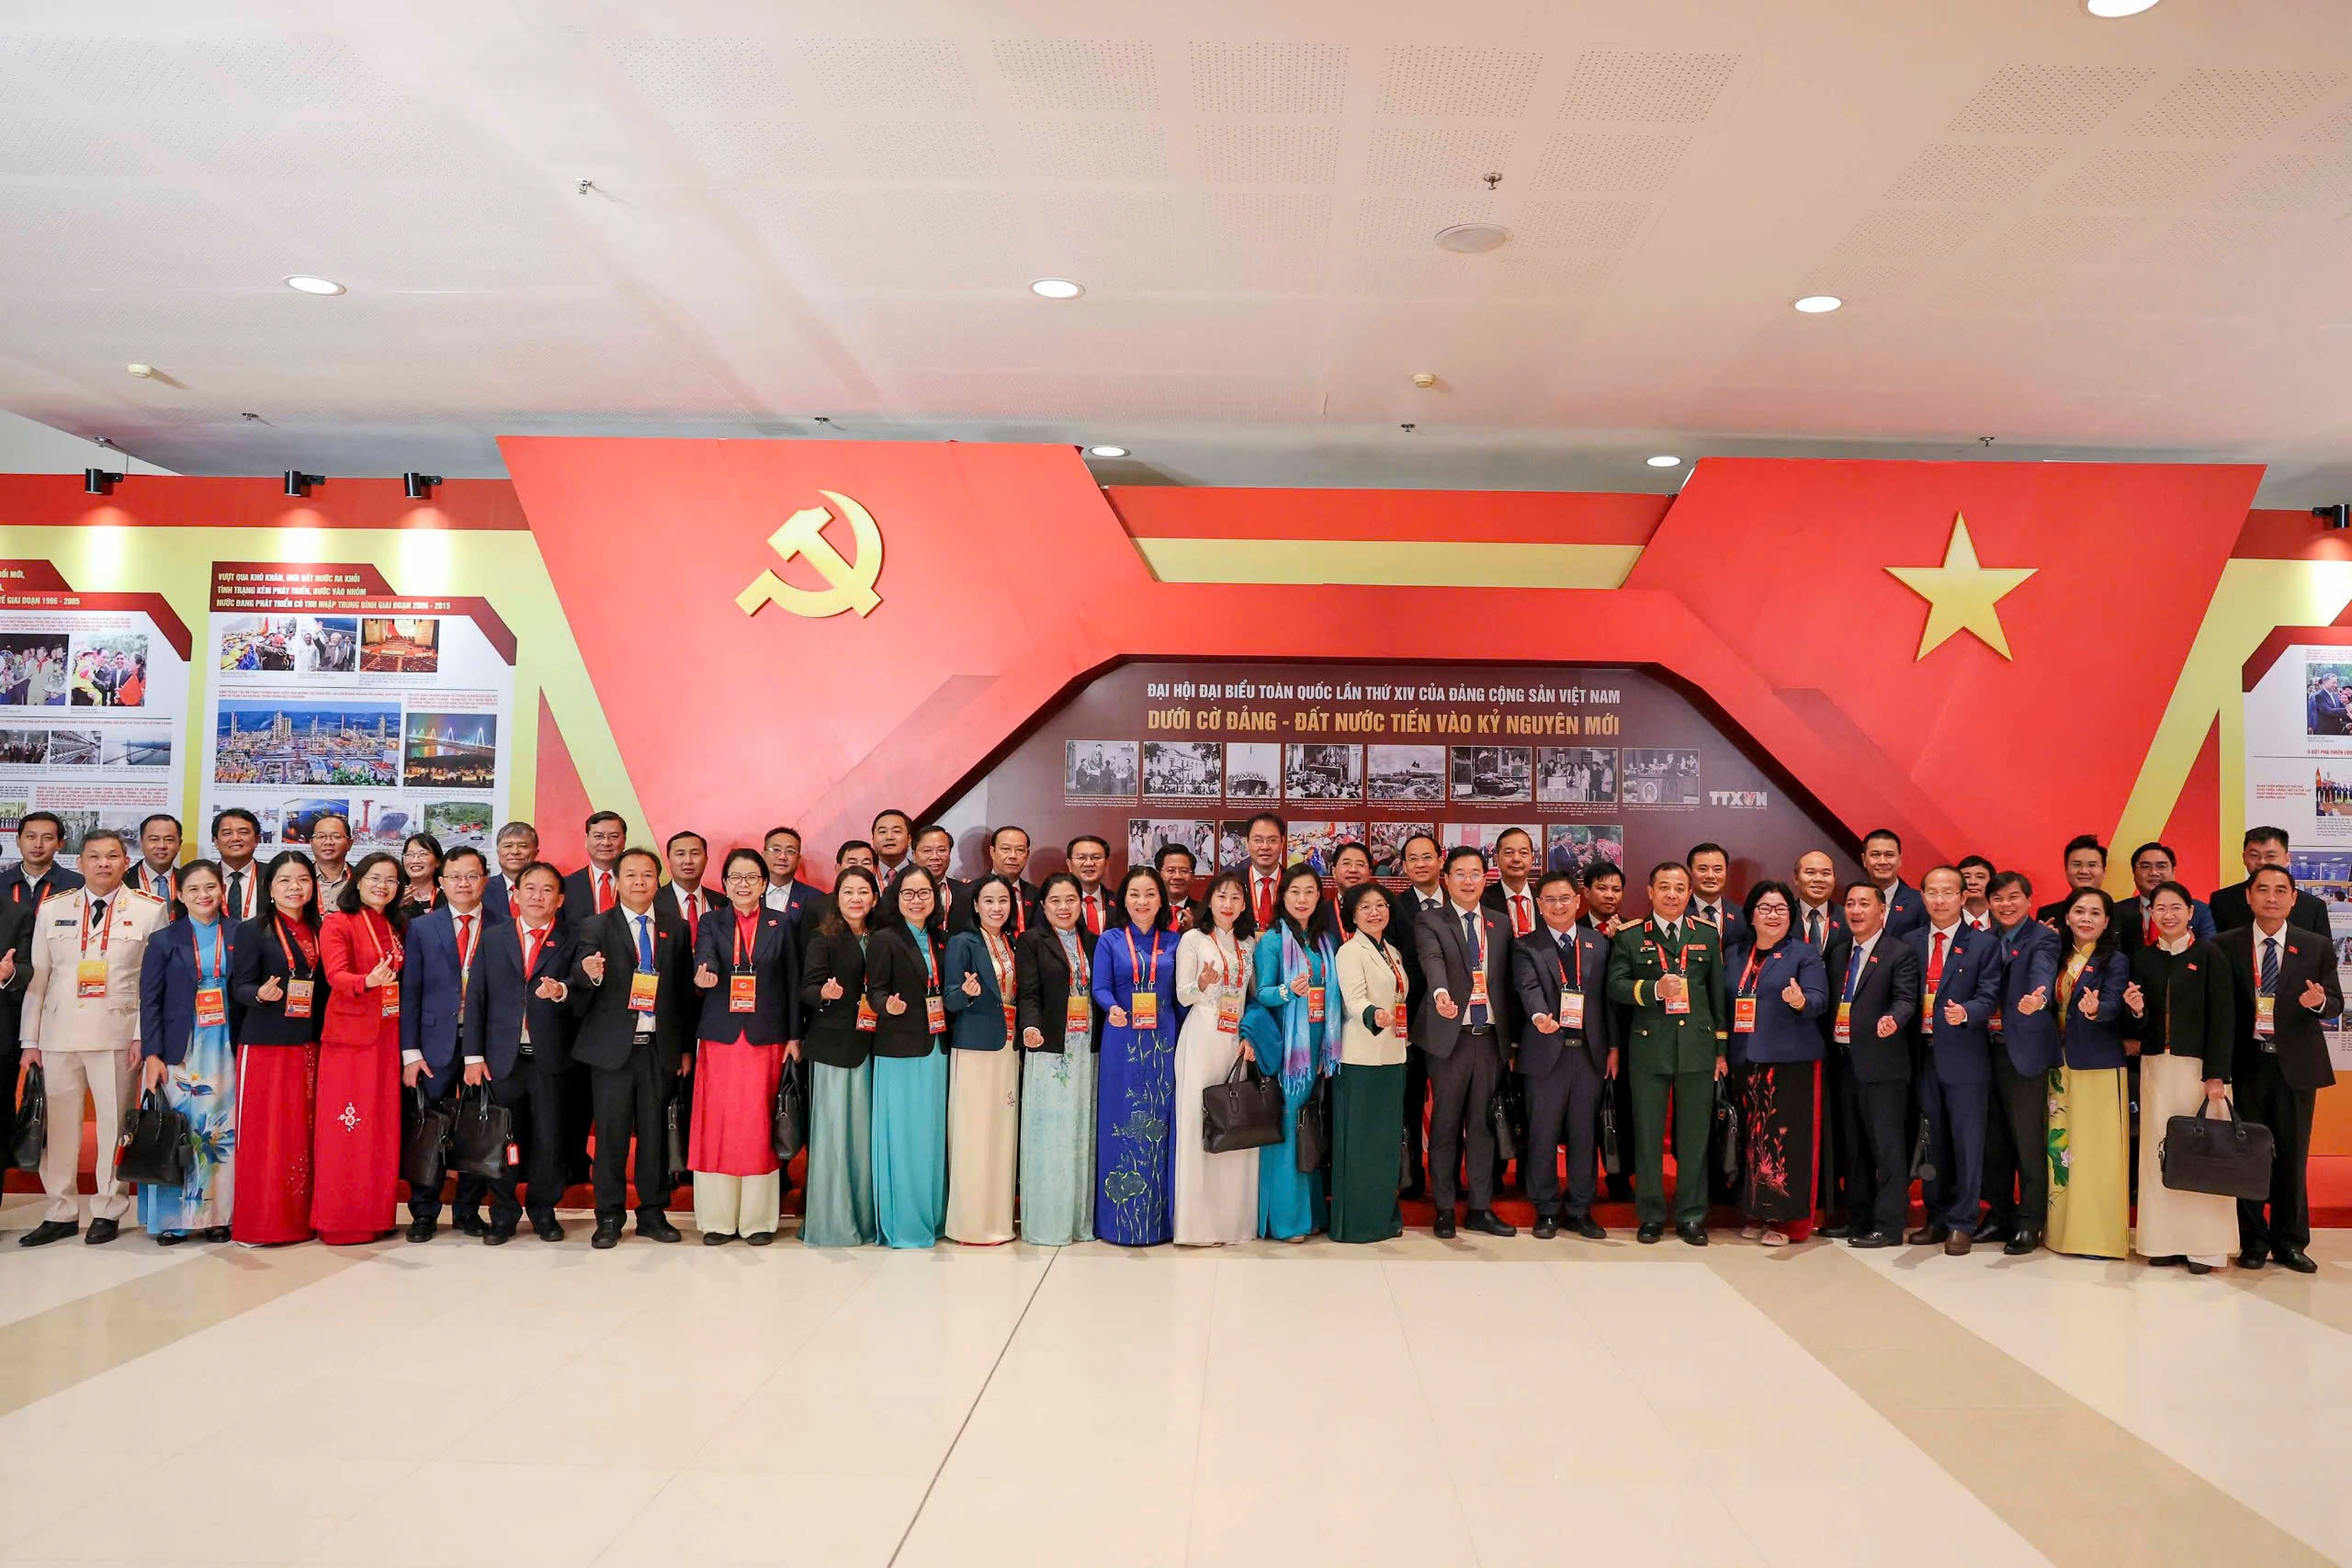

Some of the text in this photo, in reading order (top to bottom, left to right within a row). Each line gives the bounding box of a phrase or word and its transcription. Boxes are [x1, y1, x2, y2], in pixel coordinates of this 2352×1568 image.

[219, 573, 235, 582] VƯỢT
[236, 573, 249, 581] QUA
[251, 573, 264, 581] KHÓ
[315, 573, 334, 582] NƯỚC
[345, 573, 360, 582] KHỎI
[218, 585, 232, 593] TÌNH
[234, 586, 255, 595] TRẠNG
[273, 586, 289, 594] PHÁT
[333, 587, 345, 595] VÀO
[346, 587, 367, 595] NHÓM
[216, 598, 235, 606] NƯỚC
[255, 599, 272, 607] PHÁT
[294, 599, 303, 607] CÓ
[393, 602, 411, 610] ĐOẠN
[1148, 679, 1621, 705] ĐẠI HỘI ĐẠI BIỂU TOÀN QUỐC LẦN THỨ XIV CỦA ĐẢNG CỘNG SẢN VIỆT NAM
[1148, 705, 1191, 729] DƯỚI
[1196, 705, 1222, 730] CỜ
[1226, 705, 1277, 731] ĐẢNG
[1295, 705, 1330, 731] ĐẤT
[1335, 708, 1385, 732] NƯỚC
[1390, 707, 1430, 733] TIẾN
[1436, 710, 1471, 733] VÀO
[1477, 708, 1501, 734] KỶ
[1506, 711, 1579, 735] NGUYÊN
[1585, 712, 1620, 735] MỚI
[1709, 791, 1768, 807] TTXVN
